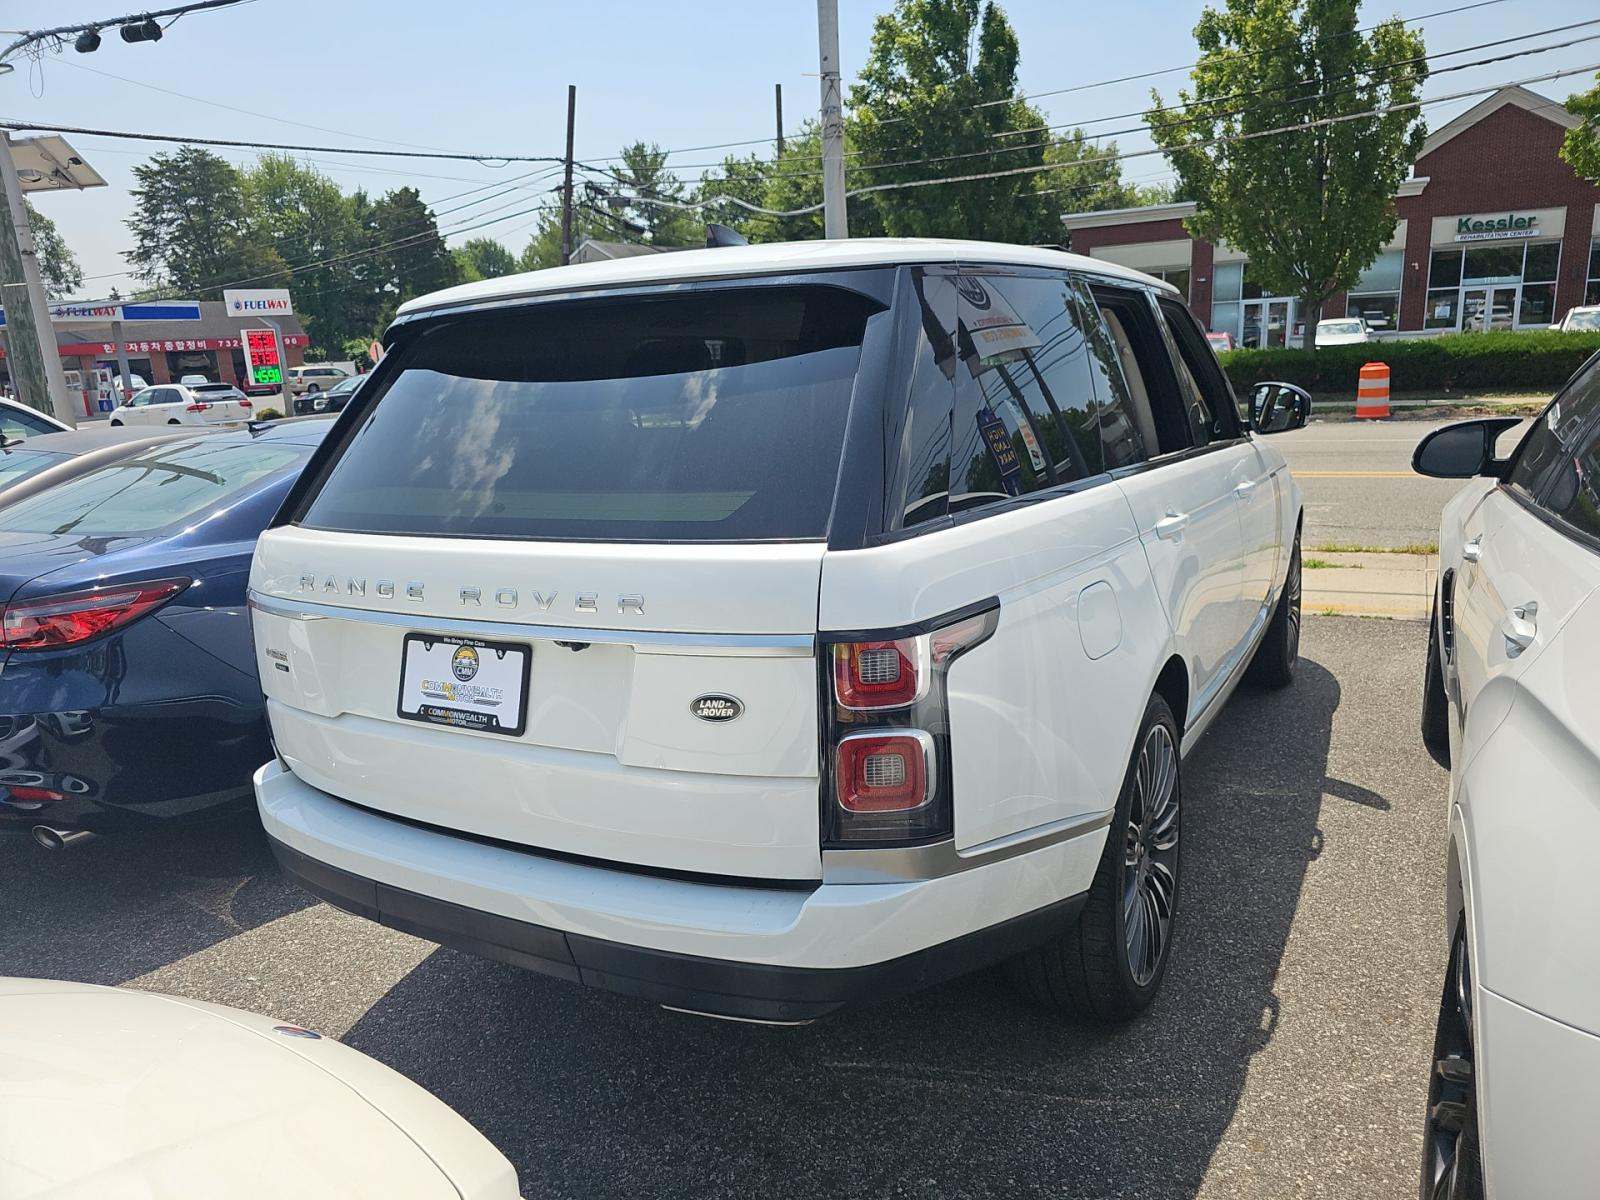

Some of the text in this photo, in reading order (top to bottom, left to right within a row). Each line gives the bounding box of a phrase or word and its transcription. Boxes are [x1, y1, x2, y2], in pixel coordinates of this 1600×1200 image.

[1457, 214, 1536, 233] Kessler
[1459, 229, 1534, 240] REHABILITATION CENTER
[244, 300, 288, 309] FUELWAY
[66, 306, 117, 317] FUELWAY
[297, 571, 646, 615] RANGE ROVER
[421, 679, 504, 700] COMMONWEALTH
[699, 700, 725, 709] LAND
[428, 707, 488, 723] COMMONWEALTH
[702, 708, 734, 717] ROVER
[447, 717, 467, 726] MOTOR
